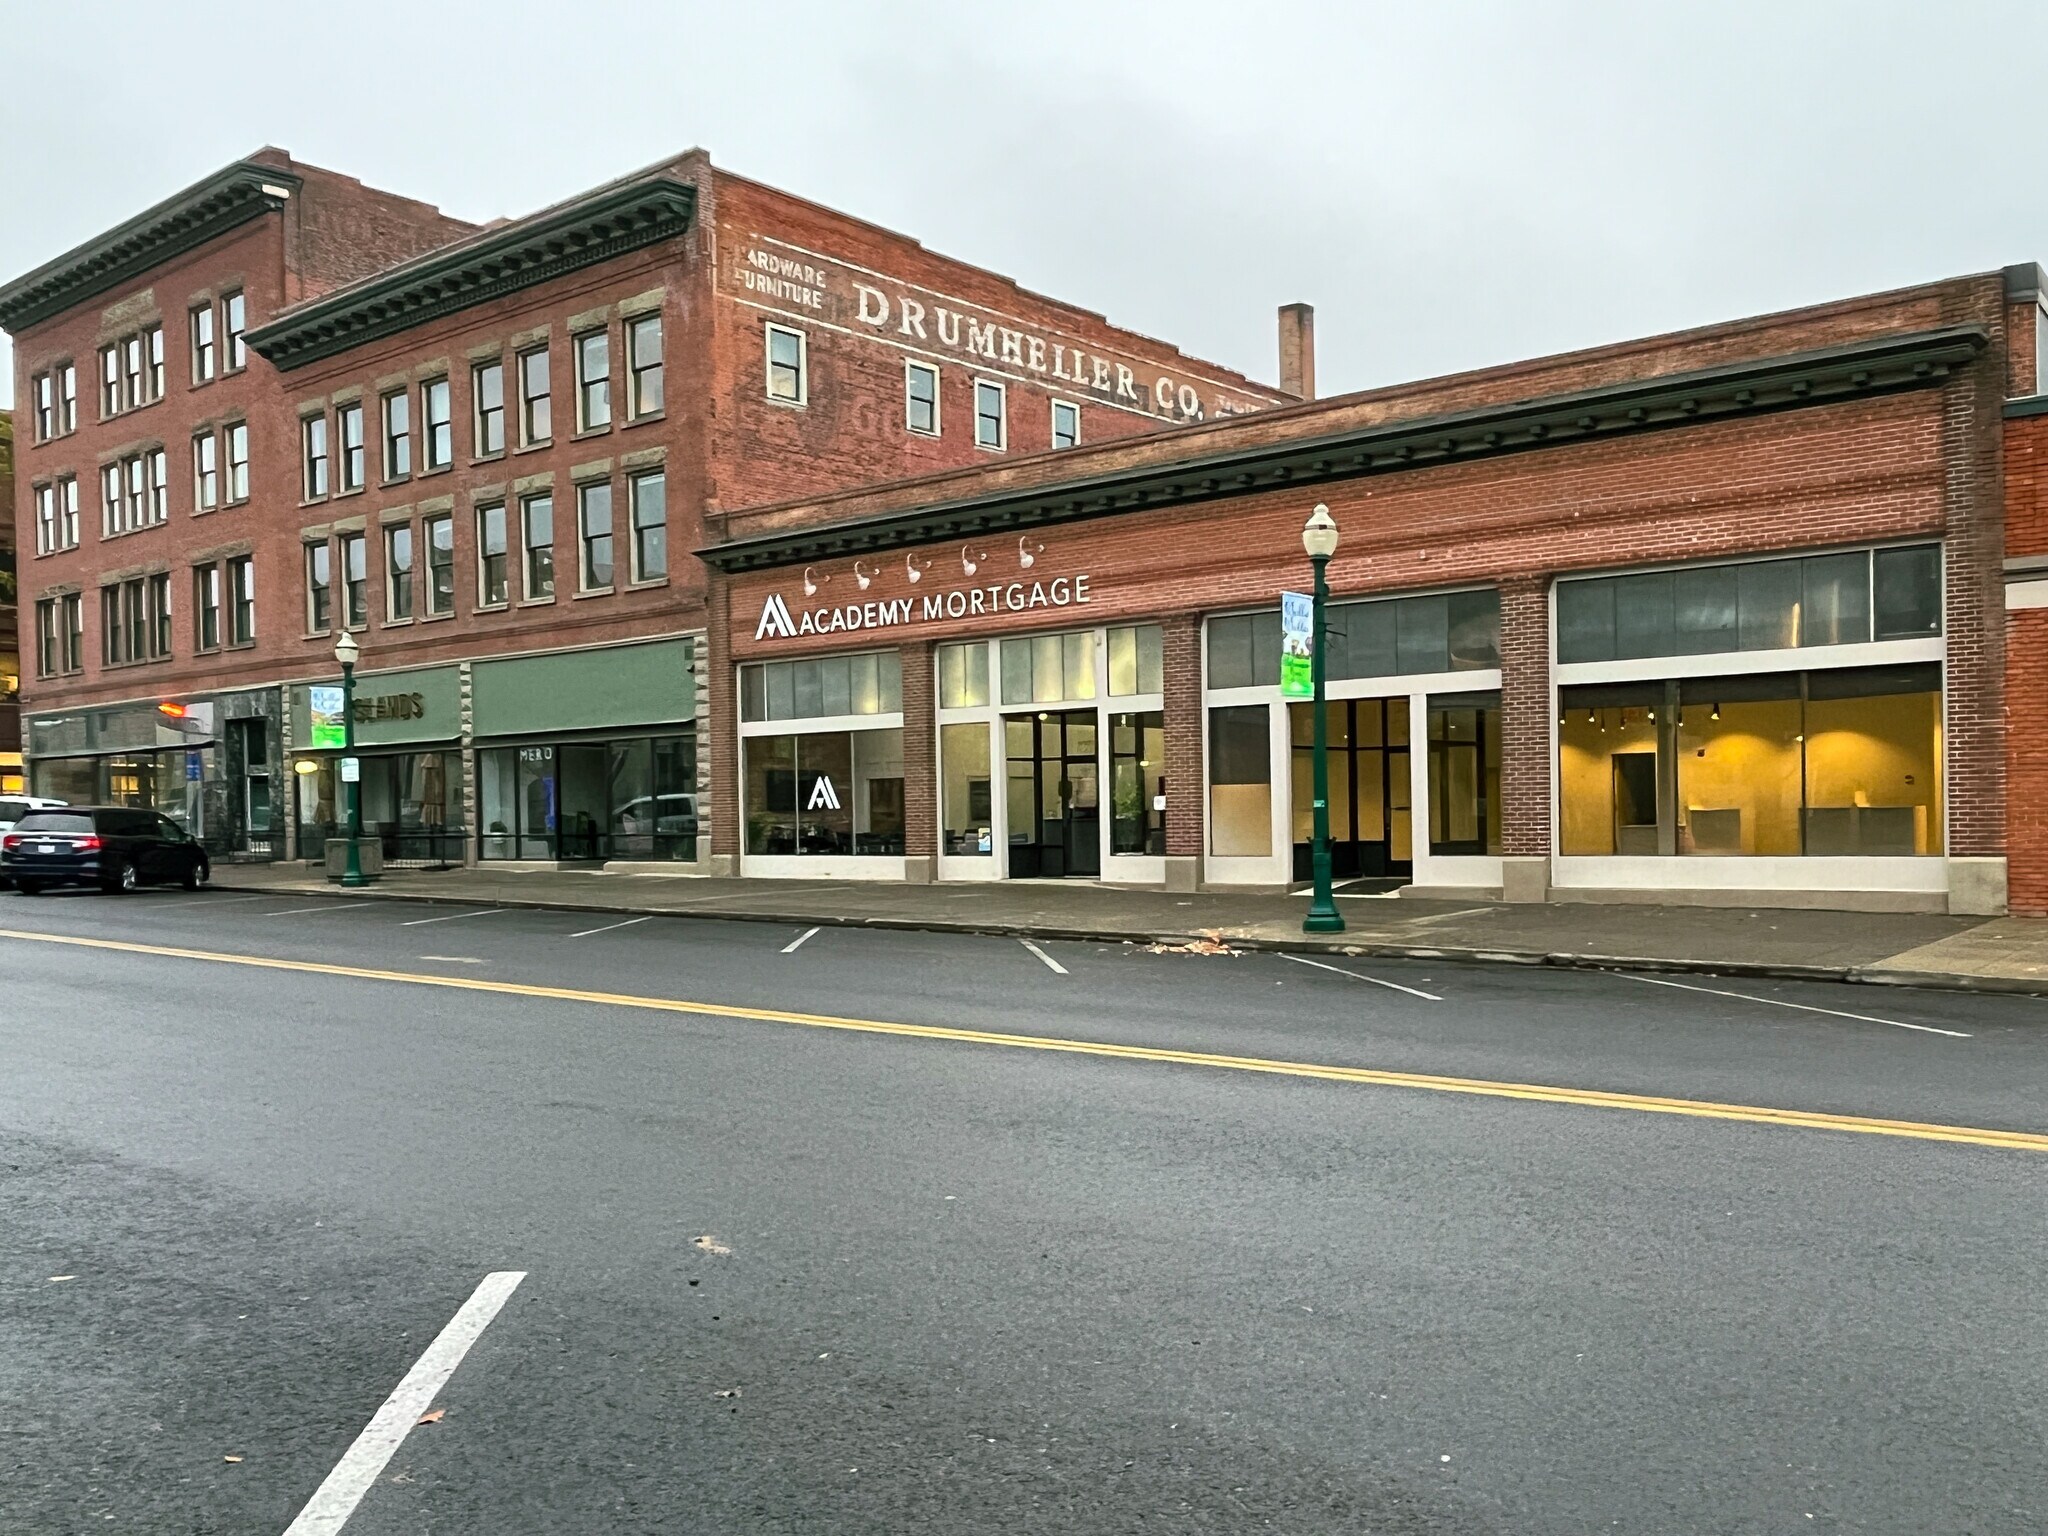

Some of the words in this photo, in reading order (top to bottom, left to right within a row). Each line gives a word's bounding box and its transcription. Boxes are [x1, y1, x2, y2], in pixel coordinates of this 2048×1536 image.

[735, 246, 827, 289] ARDWARE
[852, 281, 1138, 400] DRUMHELLER
[1155, 376, 1204, 421] CO.
[799, 598, 914, 636] ACADEMY
[923, 575, 1091, 621] MORTGAGE
